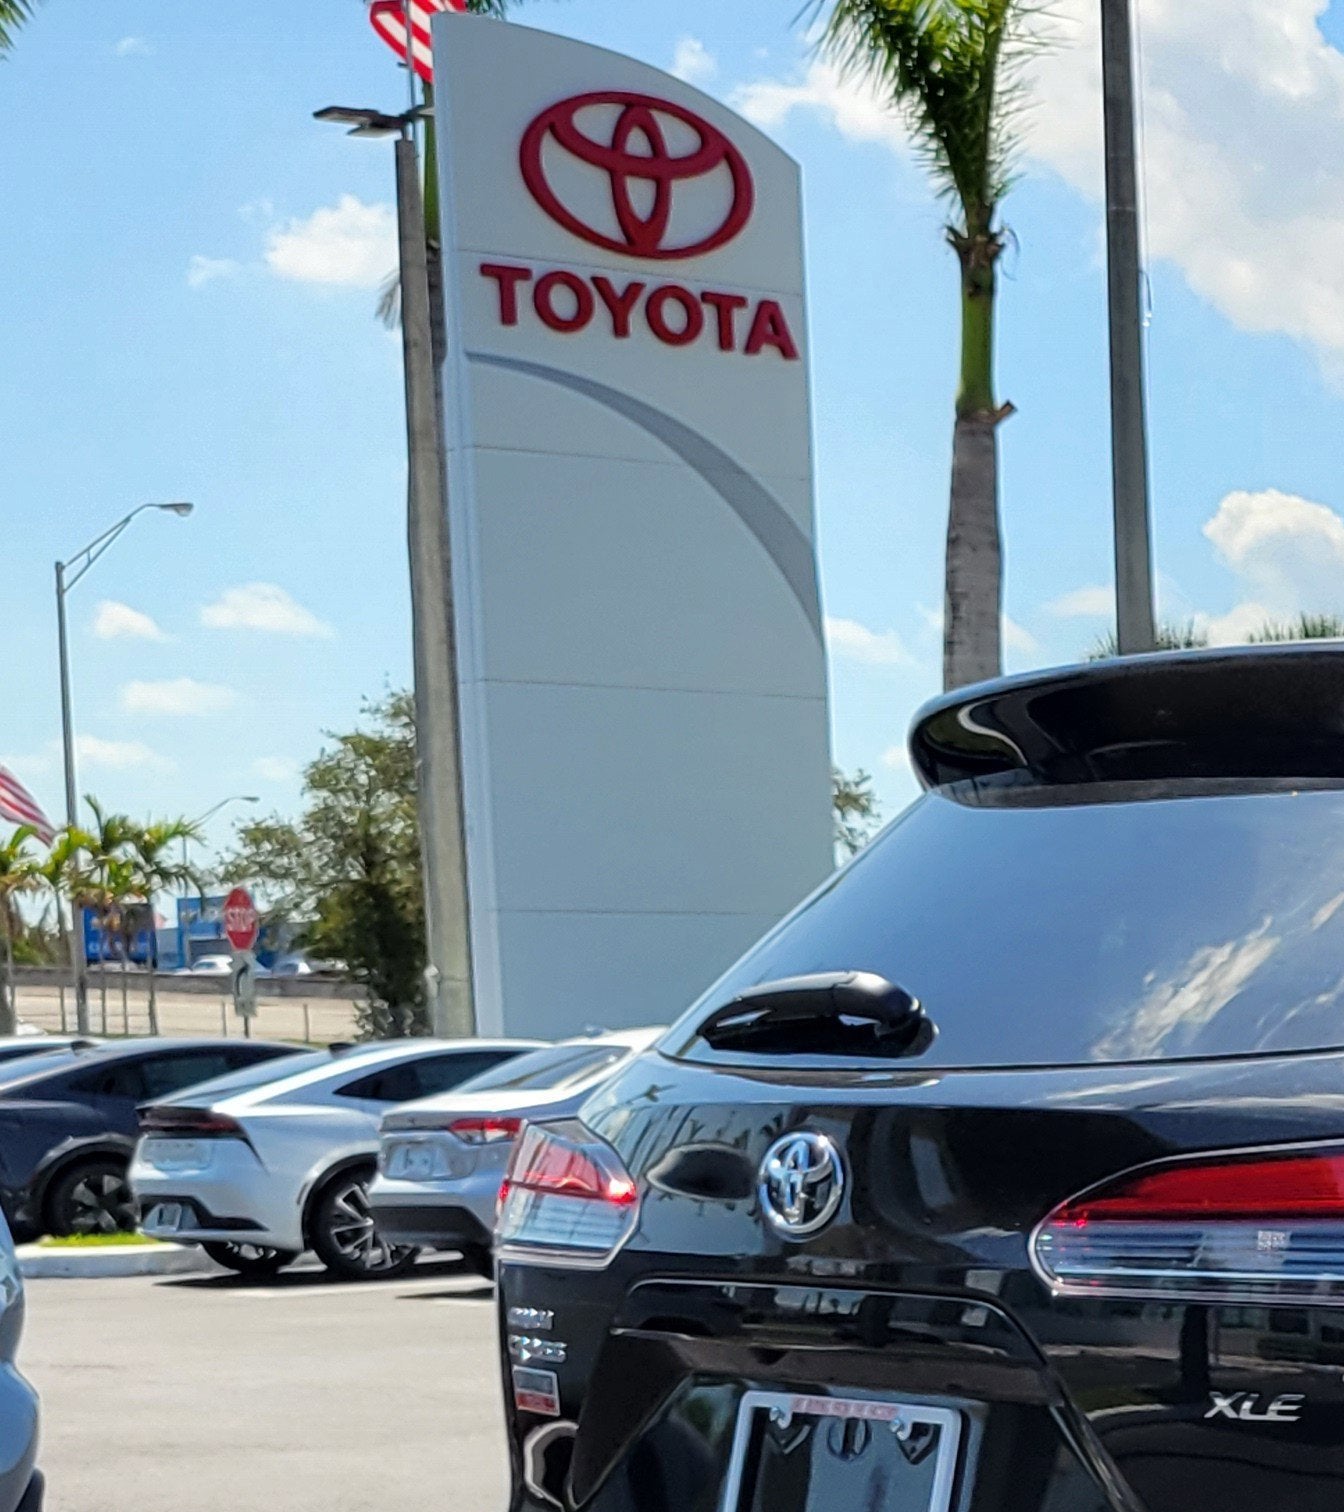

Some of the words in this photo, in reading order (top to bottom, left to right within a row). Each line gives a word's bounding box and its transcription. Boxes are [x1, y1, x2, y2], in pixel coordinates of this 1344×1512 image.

[480, 263, 800, 361] TOYOTA
[225, 907, 256, 932] STOP
[1203, 1391, 1306, 1422] XLE
